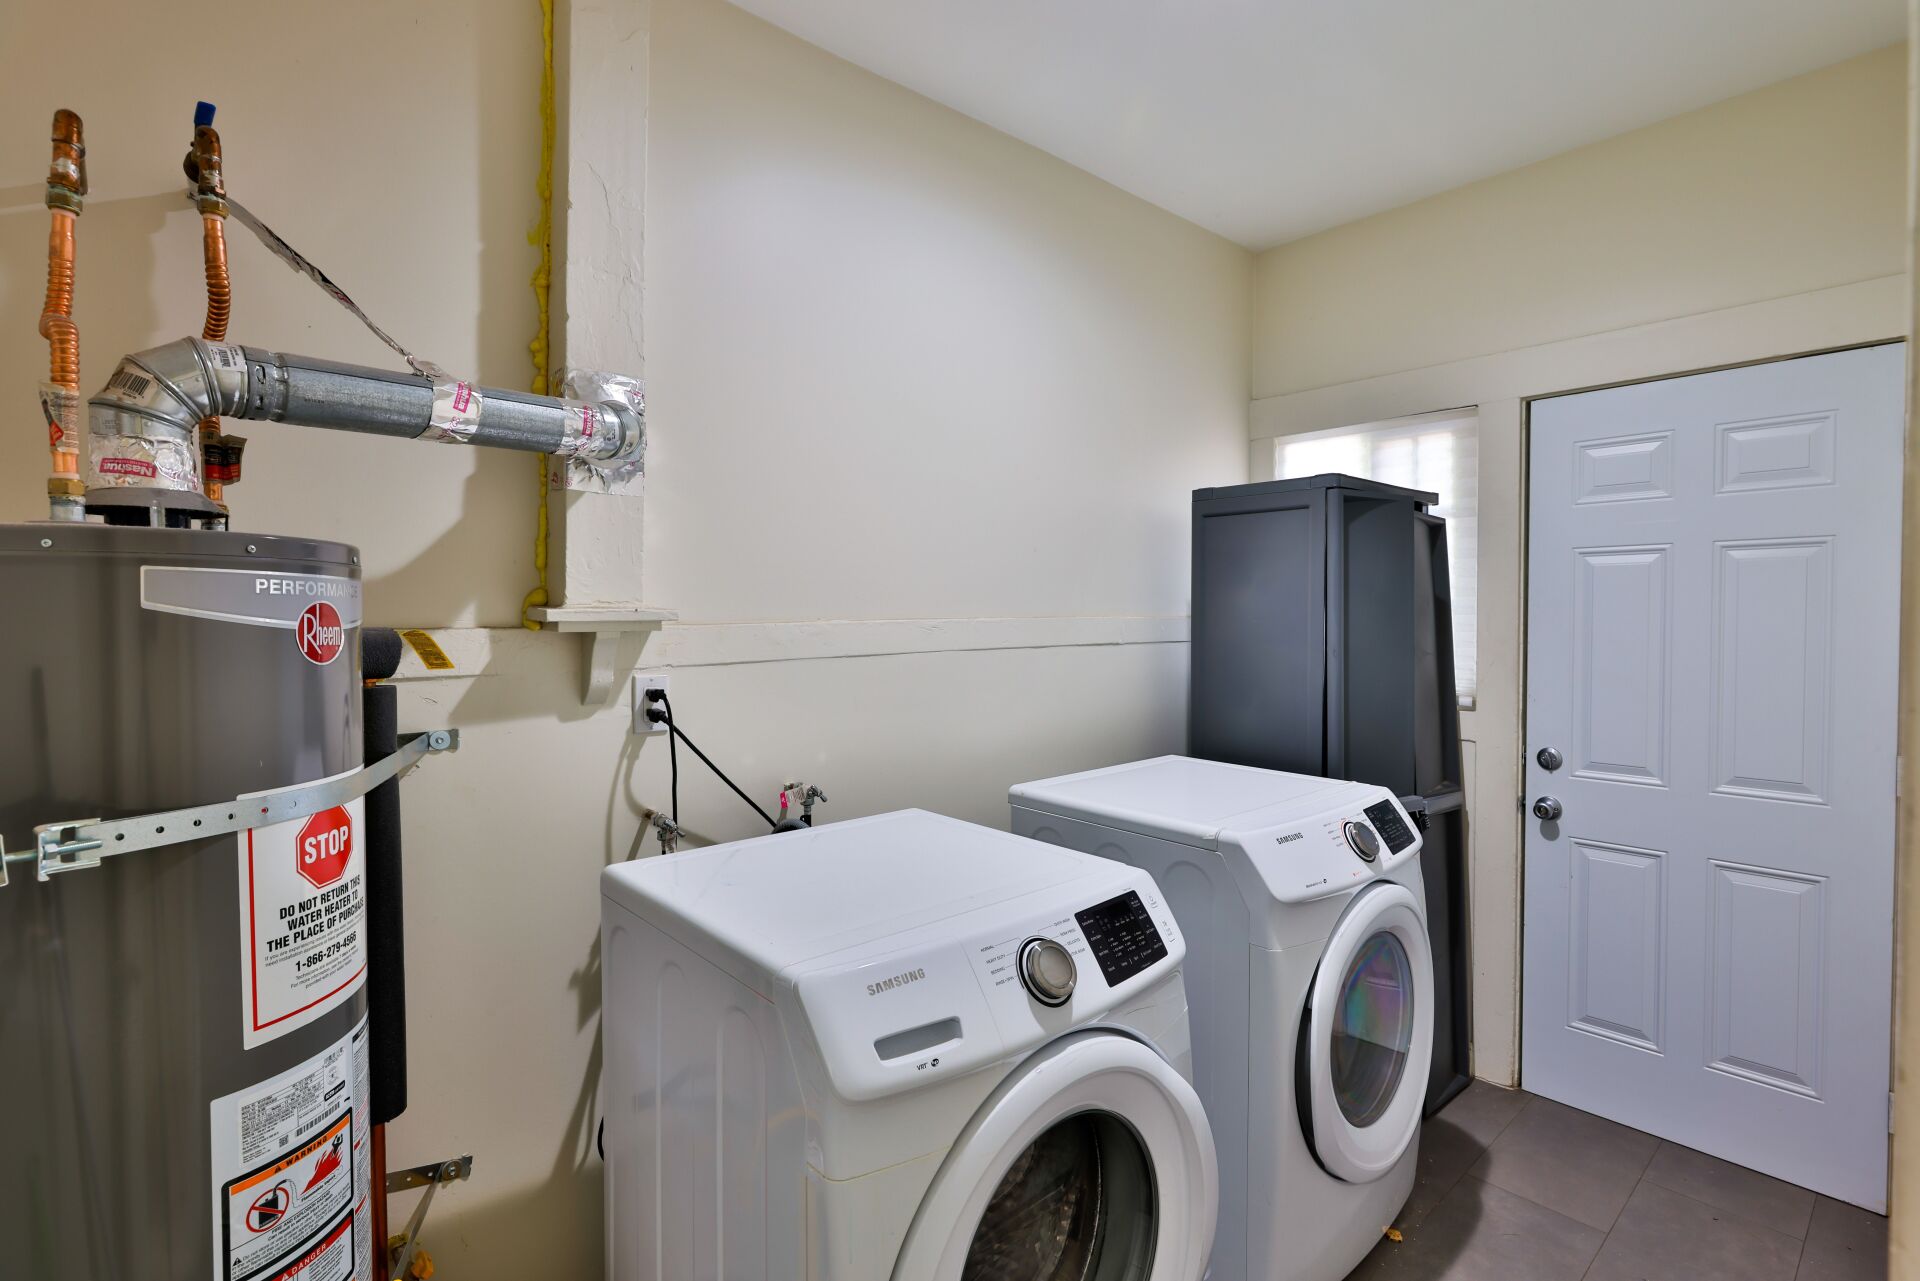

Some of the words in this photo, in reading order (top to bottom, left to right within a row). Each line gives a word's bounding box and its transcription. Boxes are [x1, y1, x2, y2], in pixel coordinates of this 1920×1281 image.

[303, 603, 341, 654] Rheem
[304, 825, 348, 864] STOP
[1276, 832, 1303, 845] SAMSUNG
[280, 904, 295, 920] DO
[299, 896, 318, 914] NOT
[321, 882, 349, 905] RETURN
[350, 874, 360, 889] THIS
[287, 909, 322, 931] WATER
[324, 894, 351, 916] HEATER
[352, 889, 358, 902] TO
[267, 934, 290, 952] THE
[294, 922, 325, 944] PLACE
[327, 915, 337, 929] OF
[339, 896, 364, 921] PURCHASE
[270, 952, 279, 960] you
[866, 967, 926, 996] SAMSUNG
[916, 1062, 928, 1071] VRT
[286, 1135, 327, 1166] WARNING
[291, 1243, 327, 1274] DANGER
